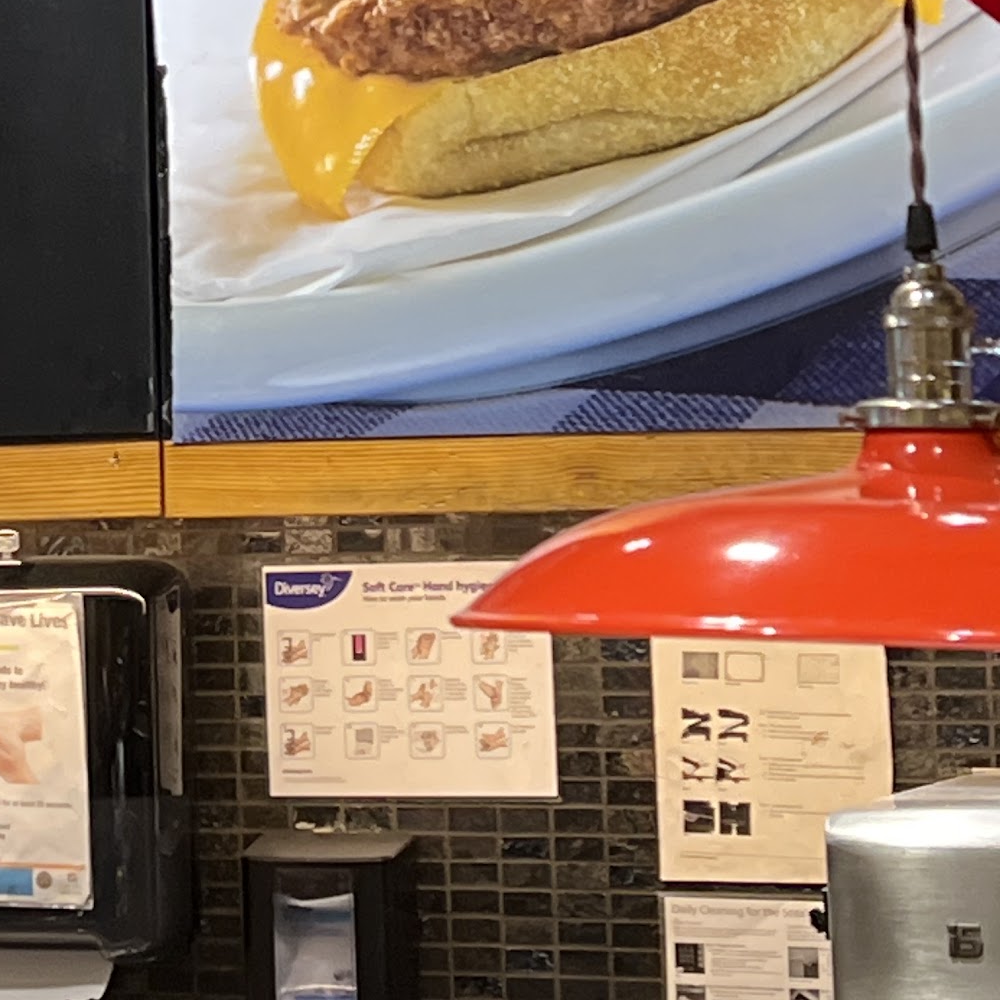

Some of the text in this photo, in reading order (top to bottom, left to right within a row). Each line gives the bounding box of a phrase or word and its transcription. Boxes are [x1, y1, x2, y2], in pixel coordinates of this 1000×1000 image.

[274, 581, 326, 598] Diversey
[423, 580, 452, 592] Hand
[30, 613, 68, 630] Lives
